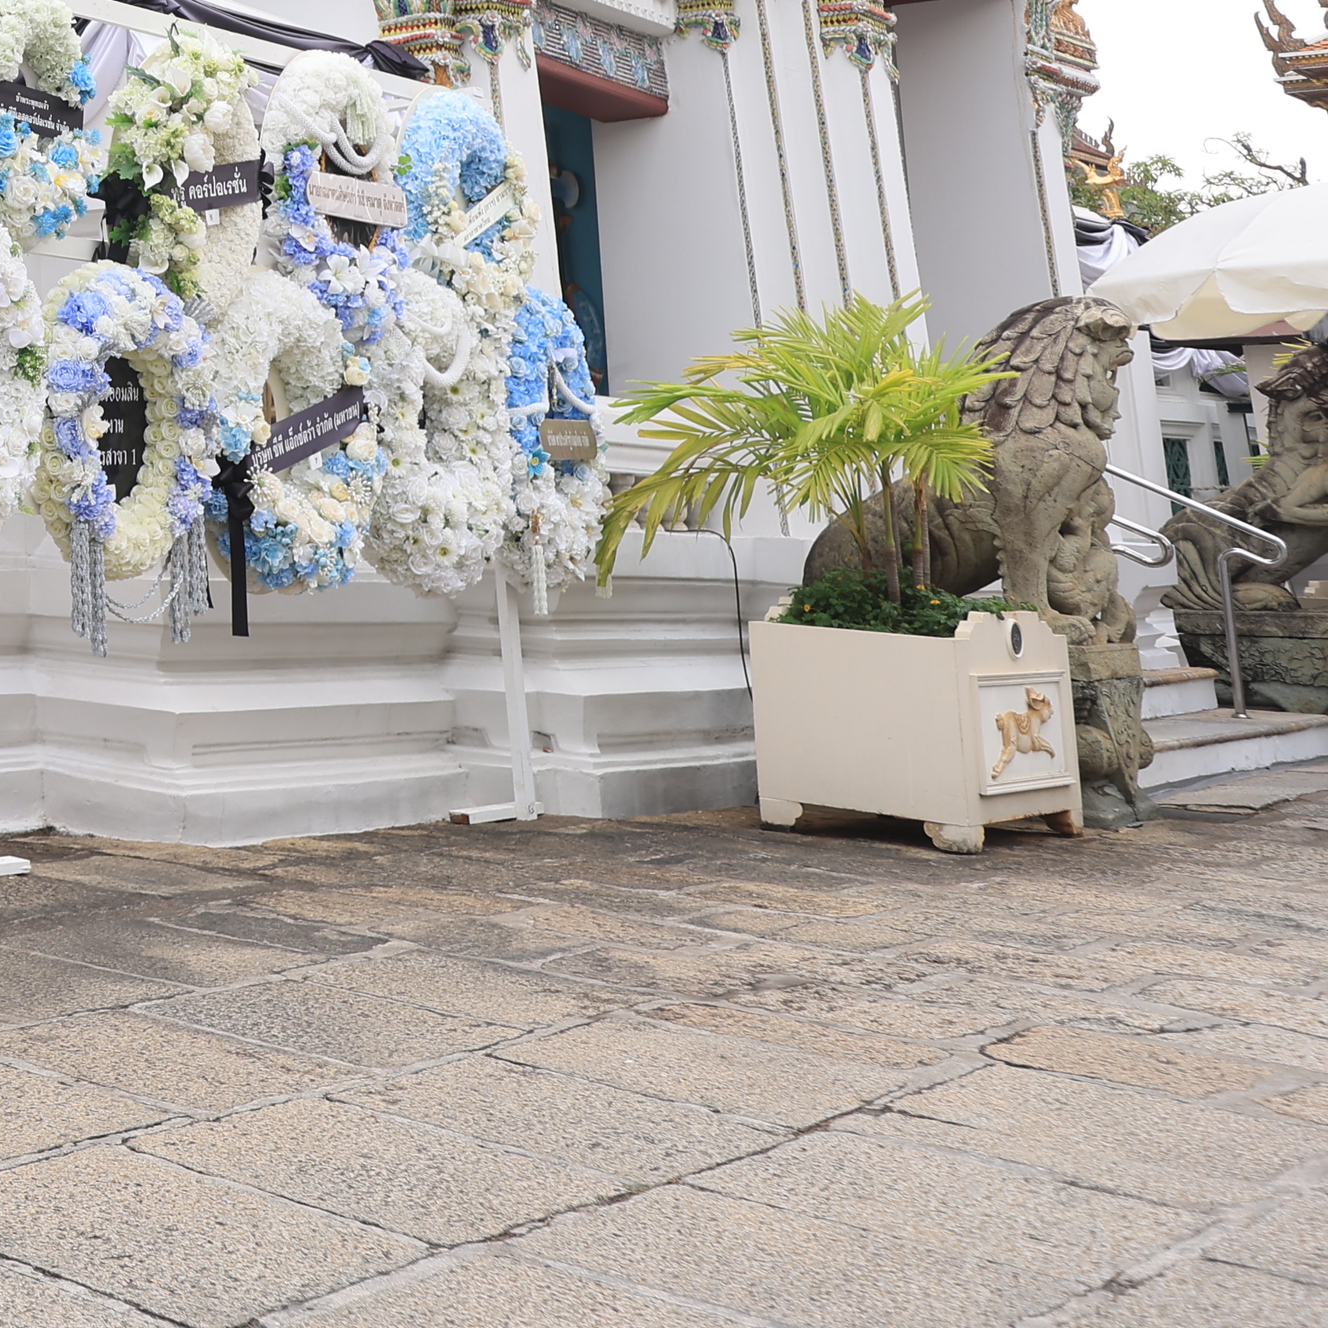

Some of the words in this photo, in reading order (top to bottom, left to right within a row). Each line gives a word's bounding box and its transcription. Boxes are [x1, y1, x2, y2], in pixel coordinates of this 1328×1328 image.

[189, 166, 247, 200] คอร์ปอเรชั่น
[316, 413, 333, 436] จำกัด
[334, 401, 360, 430] (มหาชน)
[132, 448, 136, 466] 1
